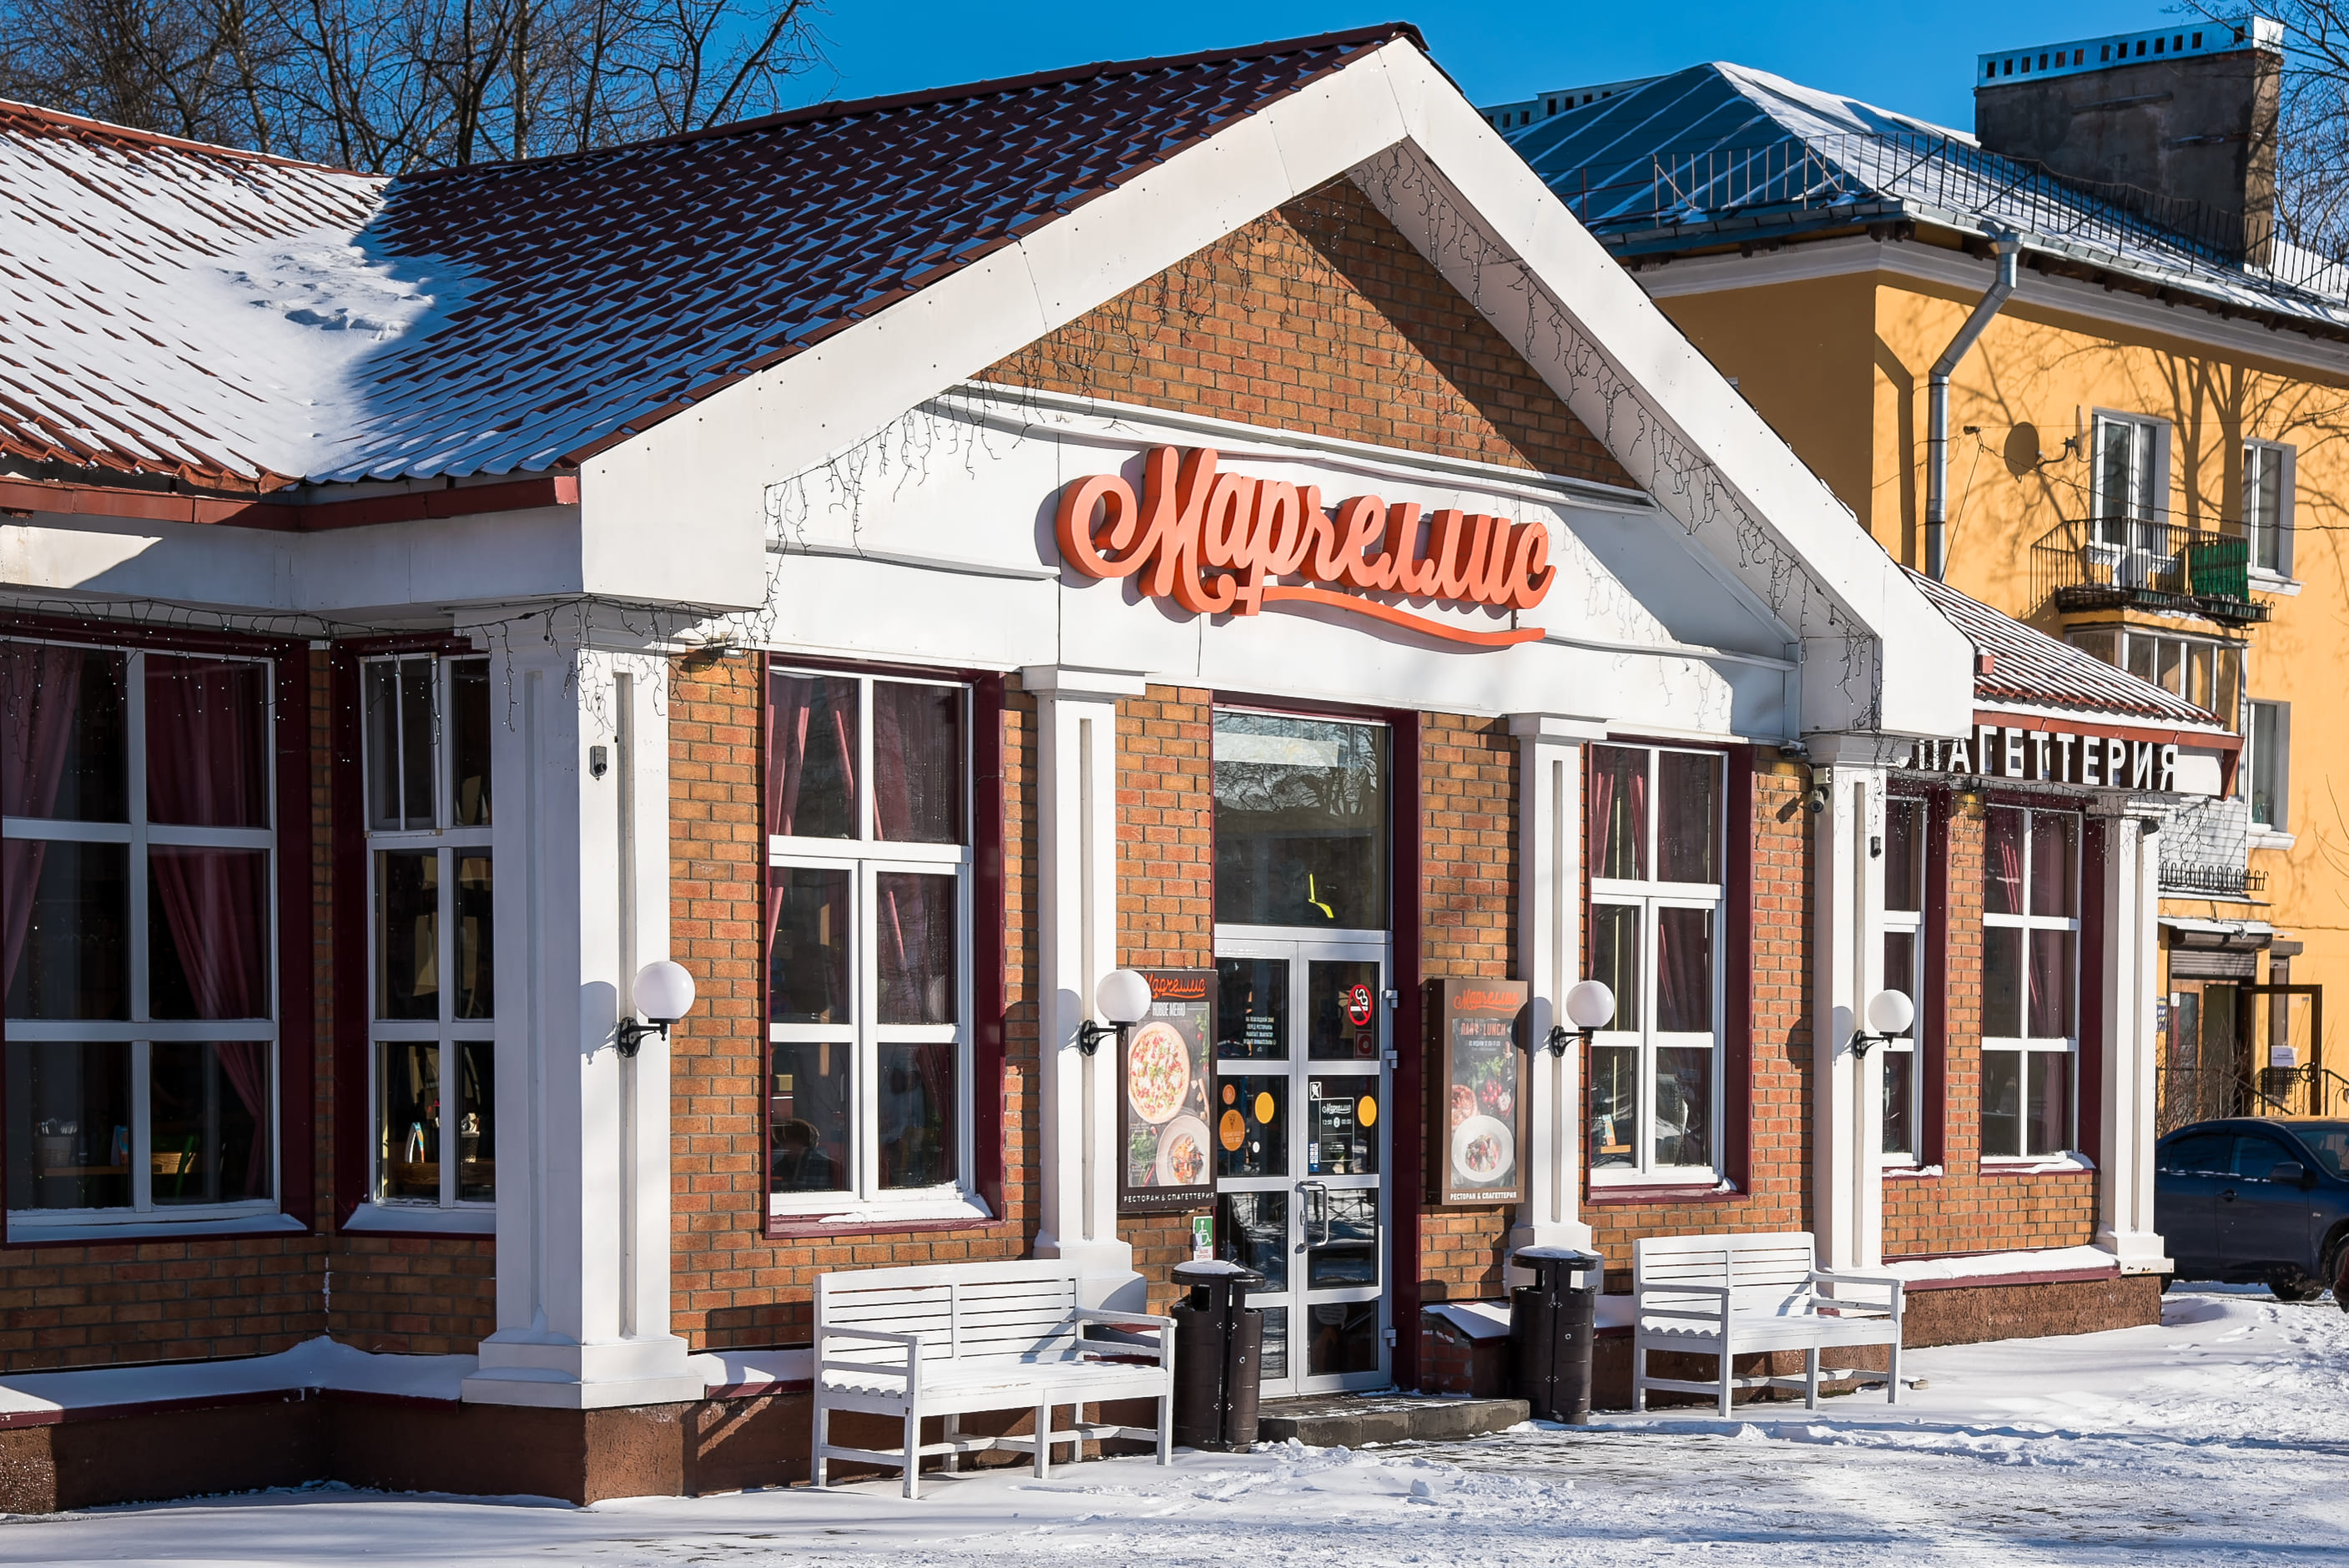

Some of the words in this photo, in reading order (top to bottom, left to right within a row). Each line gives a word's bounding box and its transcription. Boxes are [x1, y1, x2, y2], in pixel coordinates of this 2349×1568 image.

[1055, 446, 1556, 645] Марчеллис
[1896, 724, 2180, 792] ПАГЕТТЕРИЯ
[1453, 988, 1520, 1011] Марчеллис
[1483, 1022, 1506, 1036] LUNCH
[1123, 1195, 1160, 1203] РЕСТОРАН
[1167, 1192, 1215, 1201] СПАГЕТТЕРИЯ
[1482, 1191, 1517, 1199] СПАГЕТТЕРИЯ
